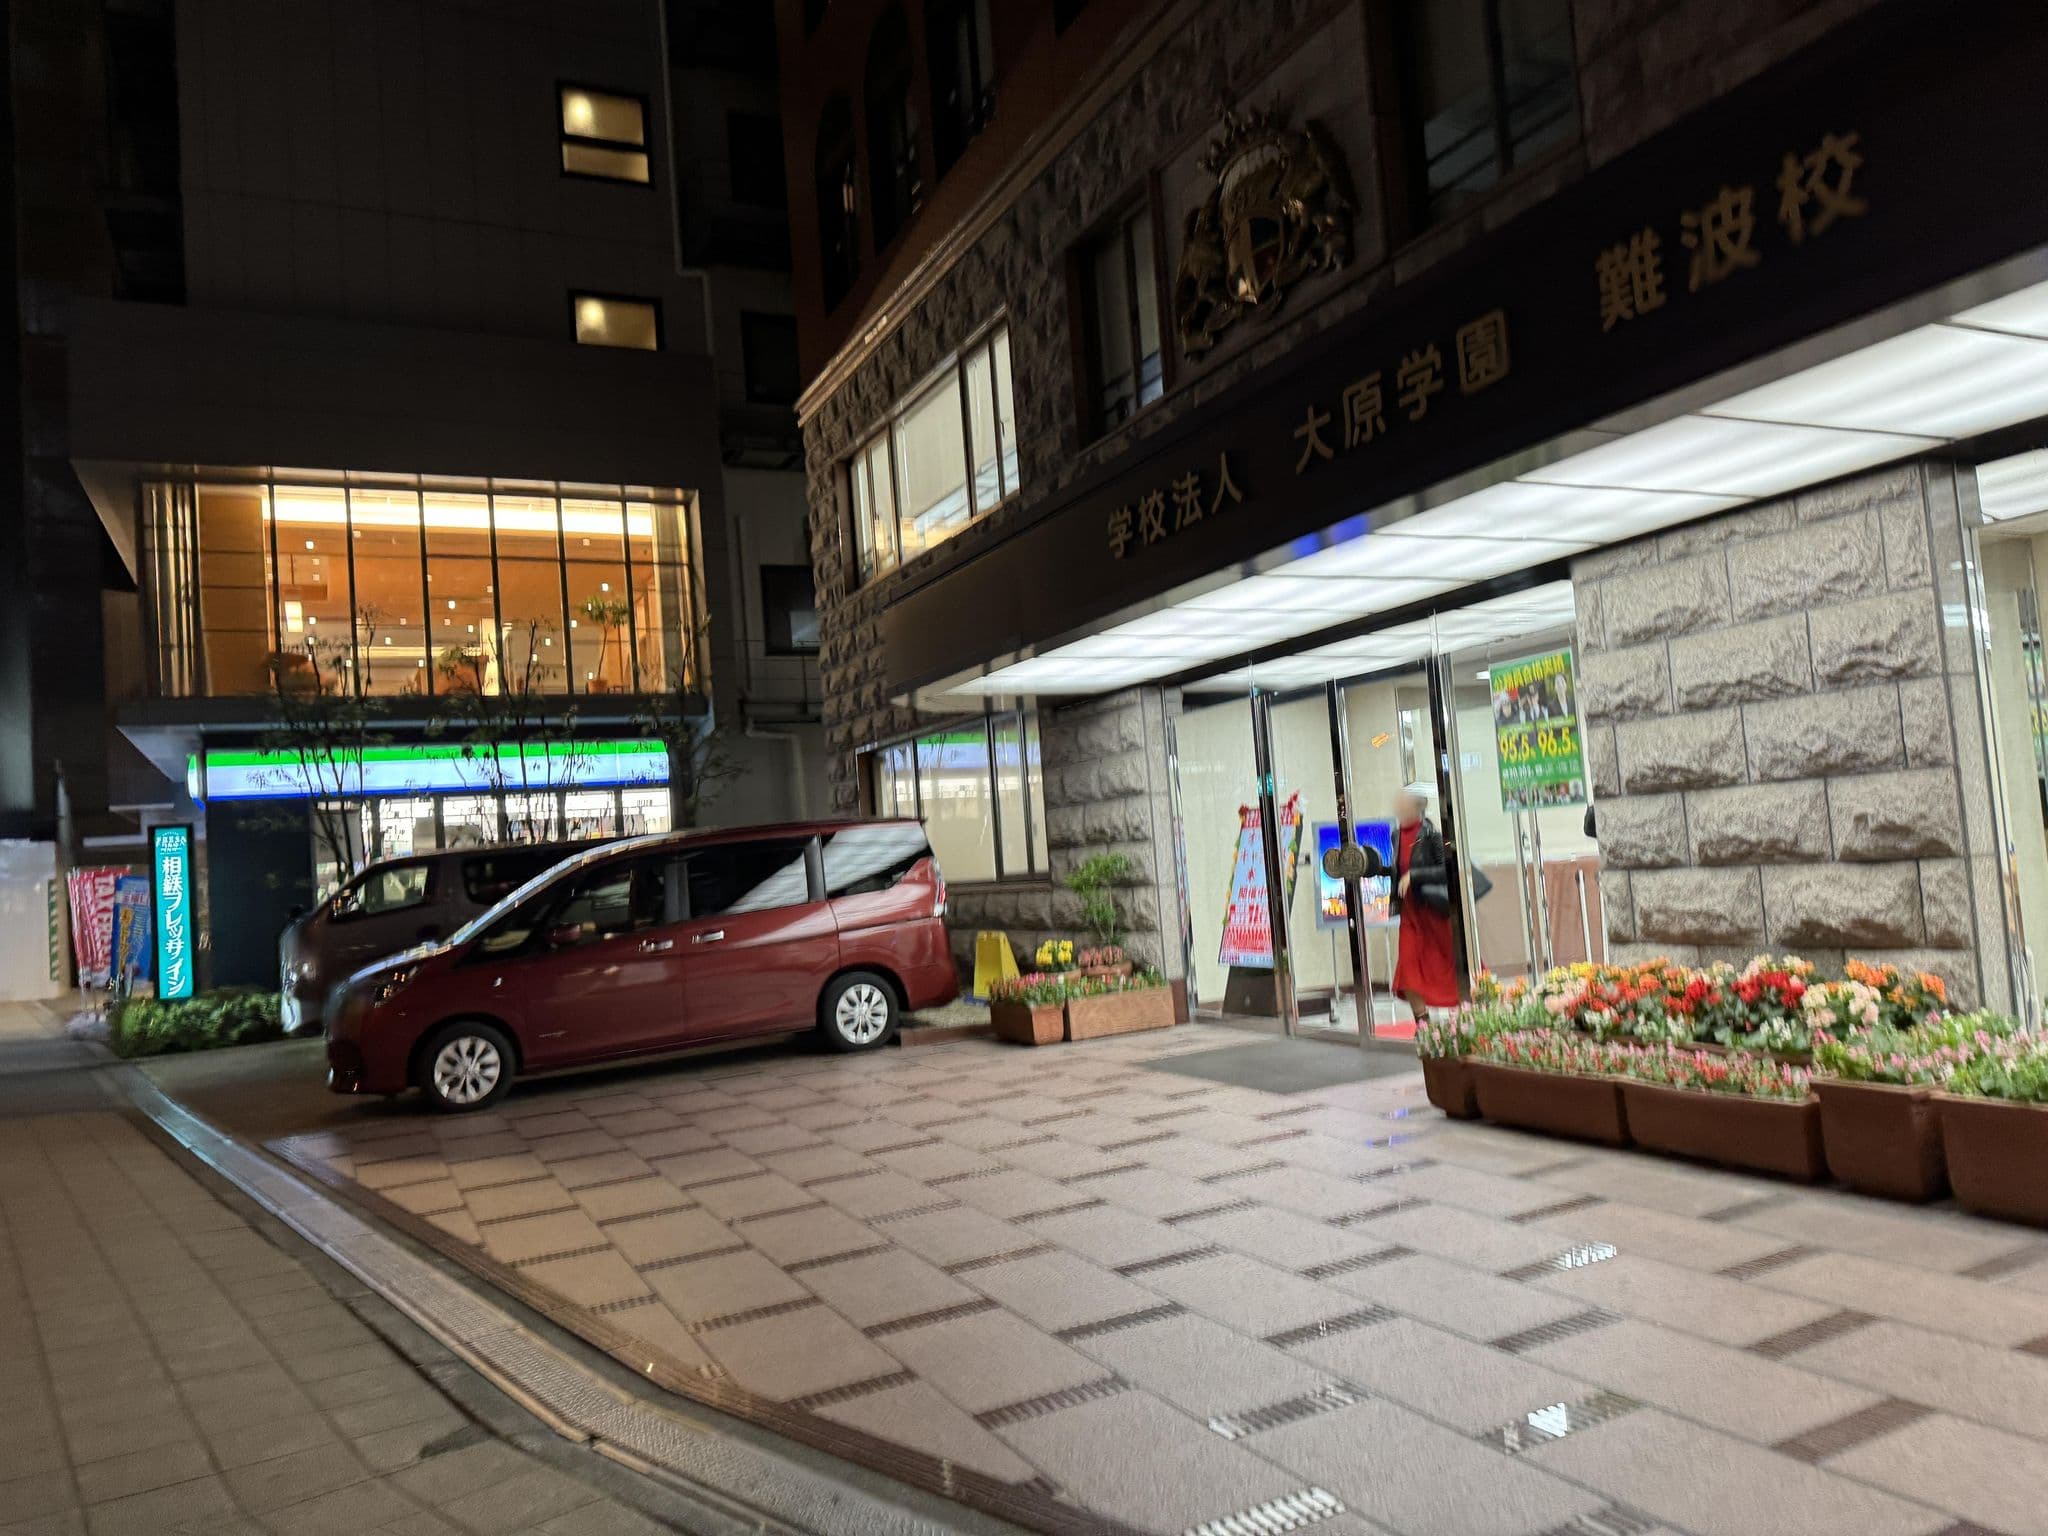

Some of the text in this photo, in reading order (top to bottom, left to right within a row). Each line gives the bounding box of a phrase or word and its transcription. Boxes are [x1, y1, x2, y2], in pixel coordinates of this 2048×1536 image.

[1107, 131, 1869, 559] 学校法人 大原学園 難波校
[162, 856, 186, 997] 相鉄フレッサイン
